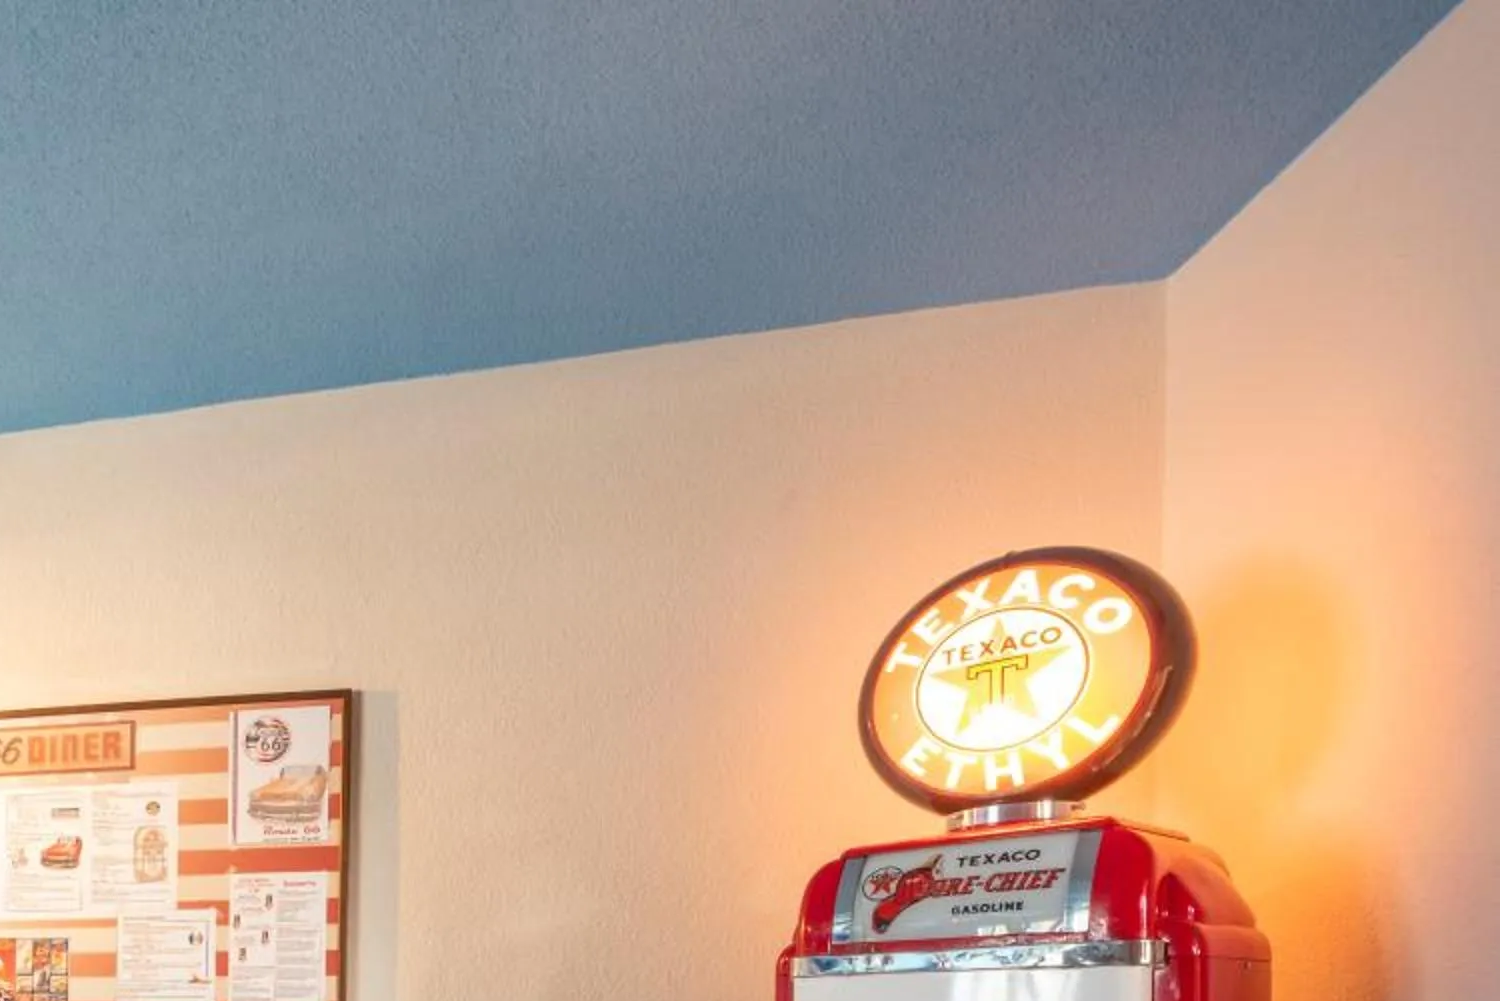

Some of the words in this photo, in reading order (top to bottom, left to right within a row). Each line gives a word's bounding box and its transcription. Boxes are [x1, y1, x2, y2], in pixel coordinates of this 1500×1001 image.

[885, 568, 1133, 673] TEXACO
[942, 626, 1063, 665] TEXACO
[966, 653, 1029, 704] T
[28, 731, 121, 765] DINER
[900, 714, 1120, 791] ETHYL
[956, 849, 1041, 868] TEXACO
[951, 899, 1024, 916] GASOLINE
